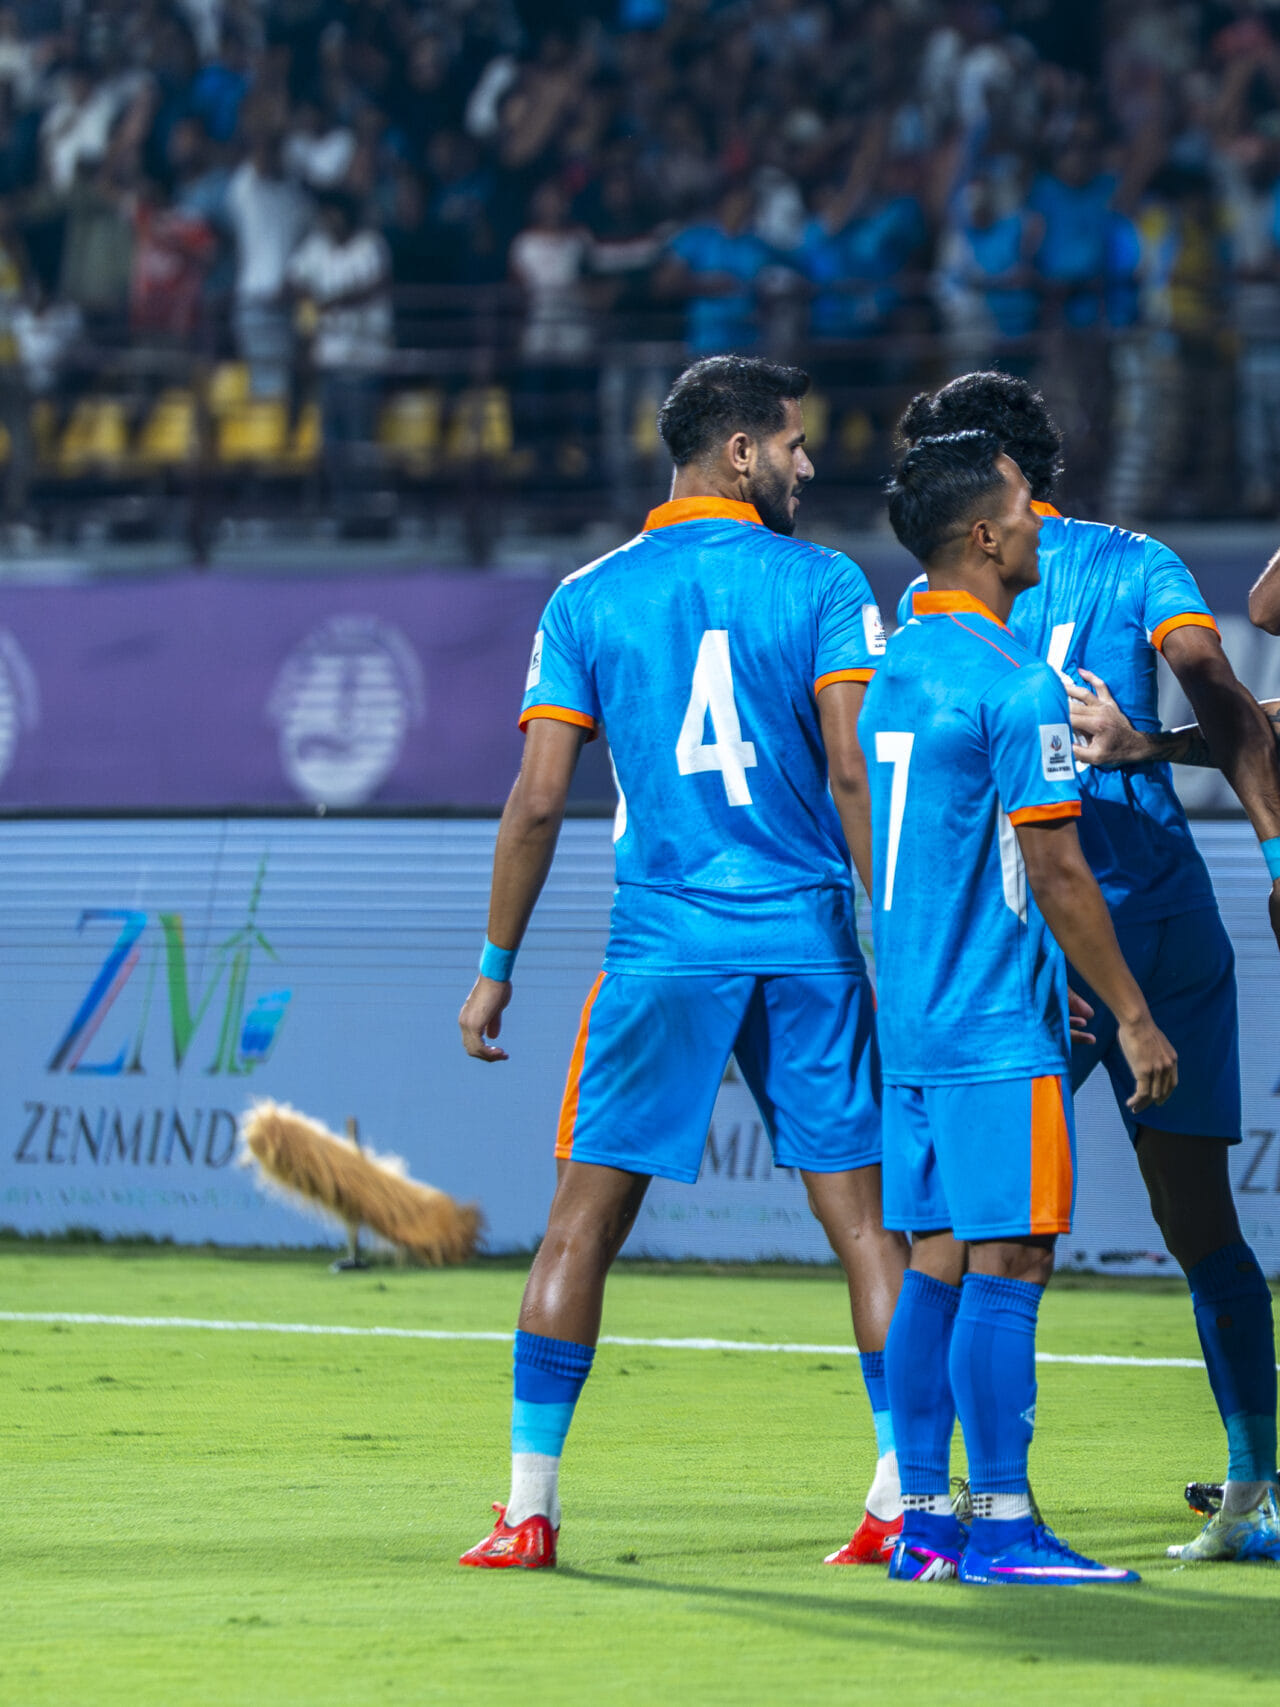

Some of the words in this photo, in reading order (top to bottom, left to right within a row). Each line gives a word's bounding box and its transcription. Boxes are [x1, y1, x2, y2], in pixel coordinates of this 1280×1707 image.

[676, 630, 757, 806] 4
[875, 731, 915, 911] 7
[14, 1100, 238, 1169] ZENMIND
